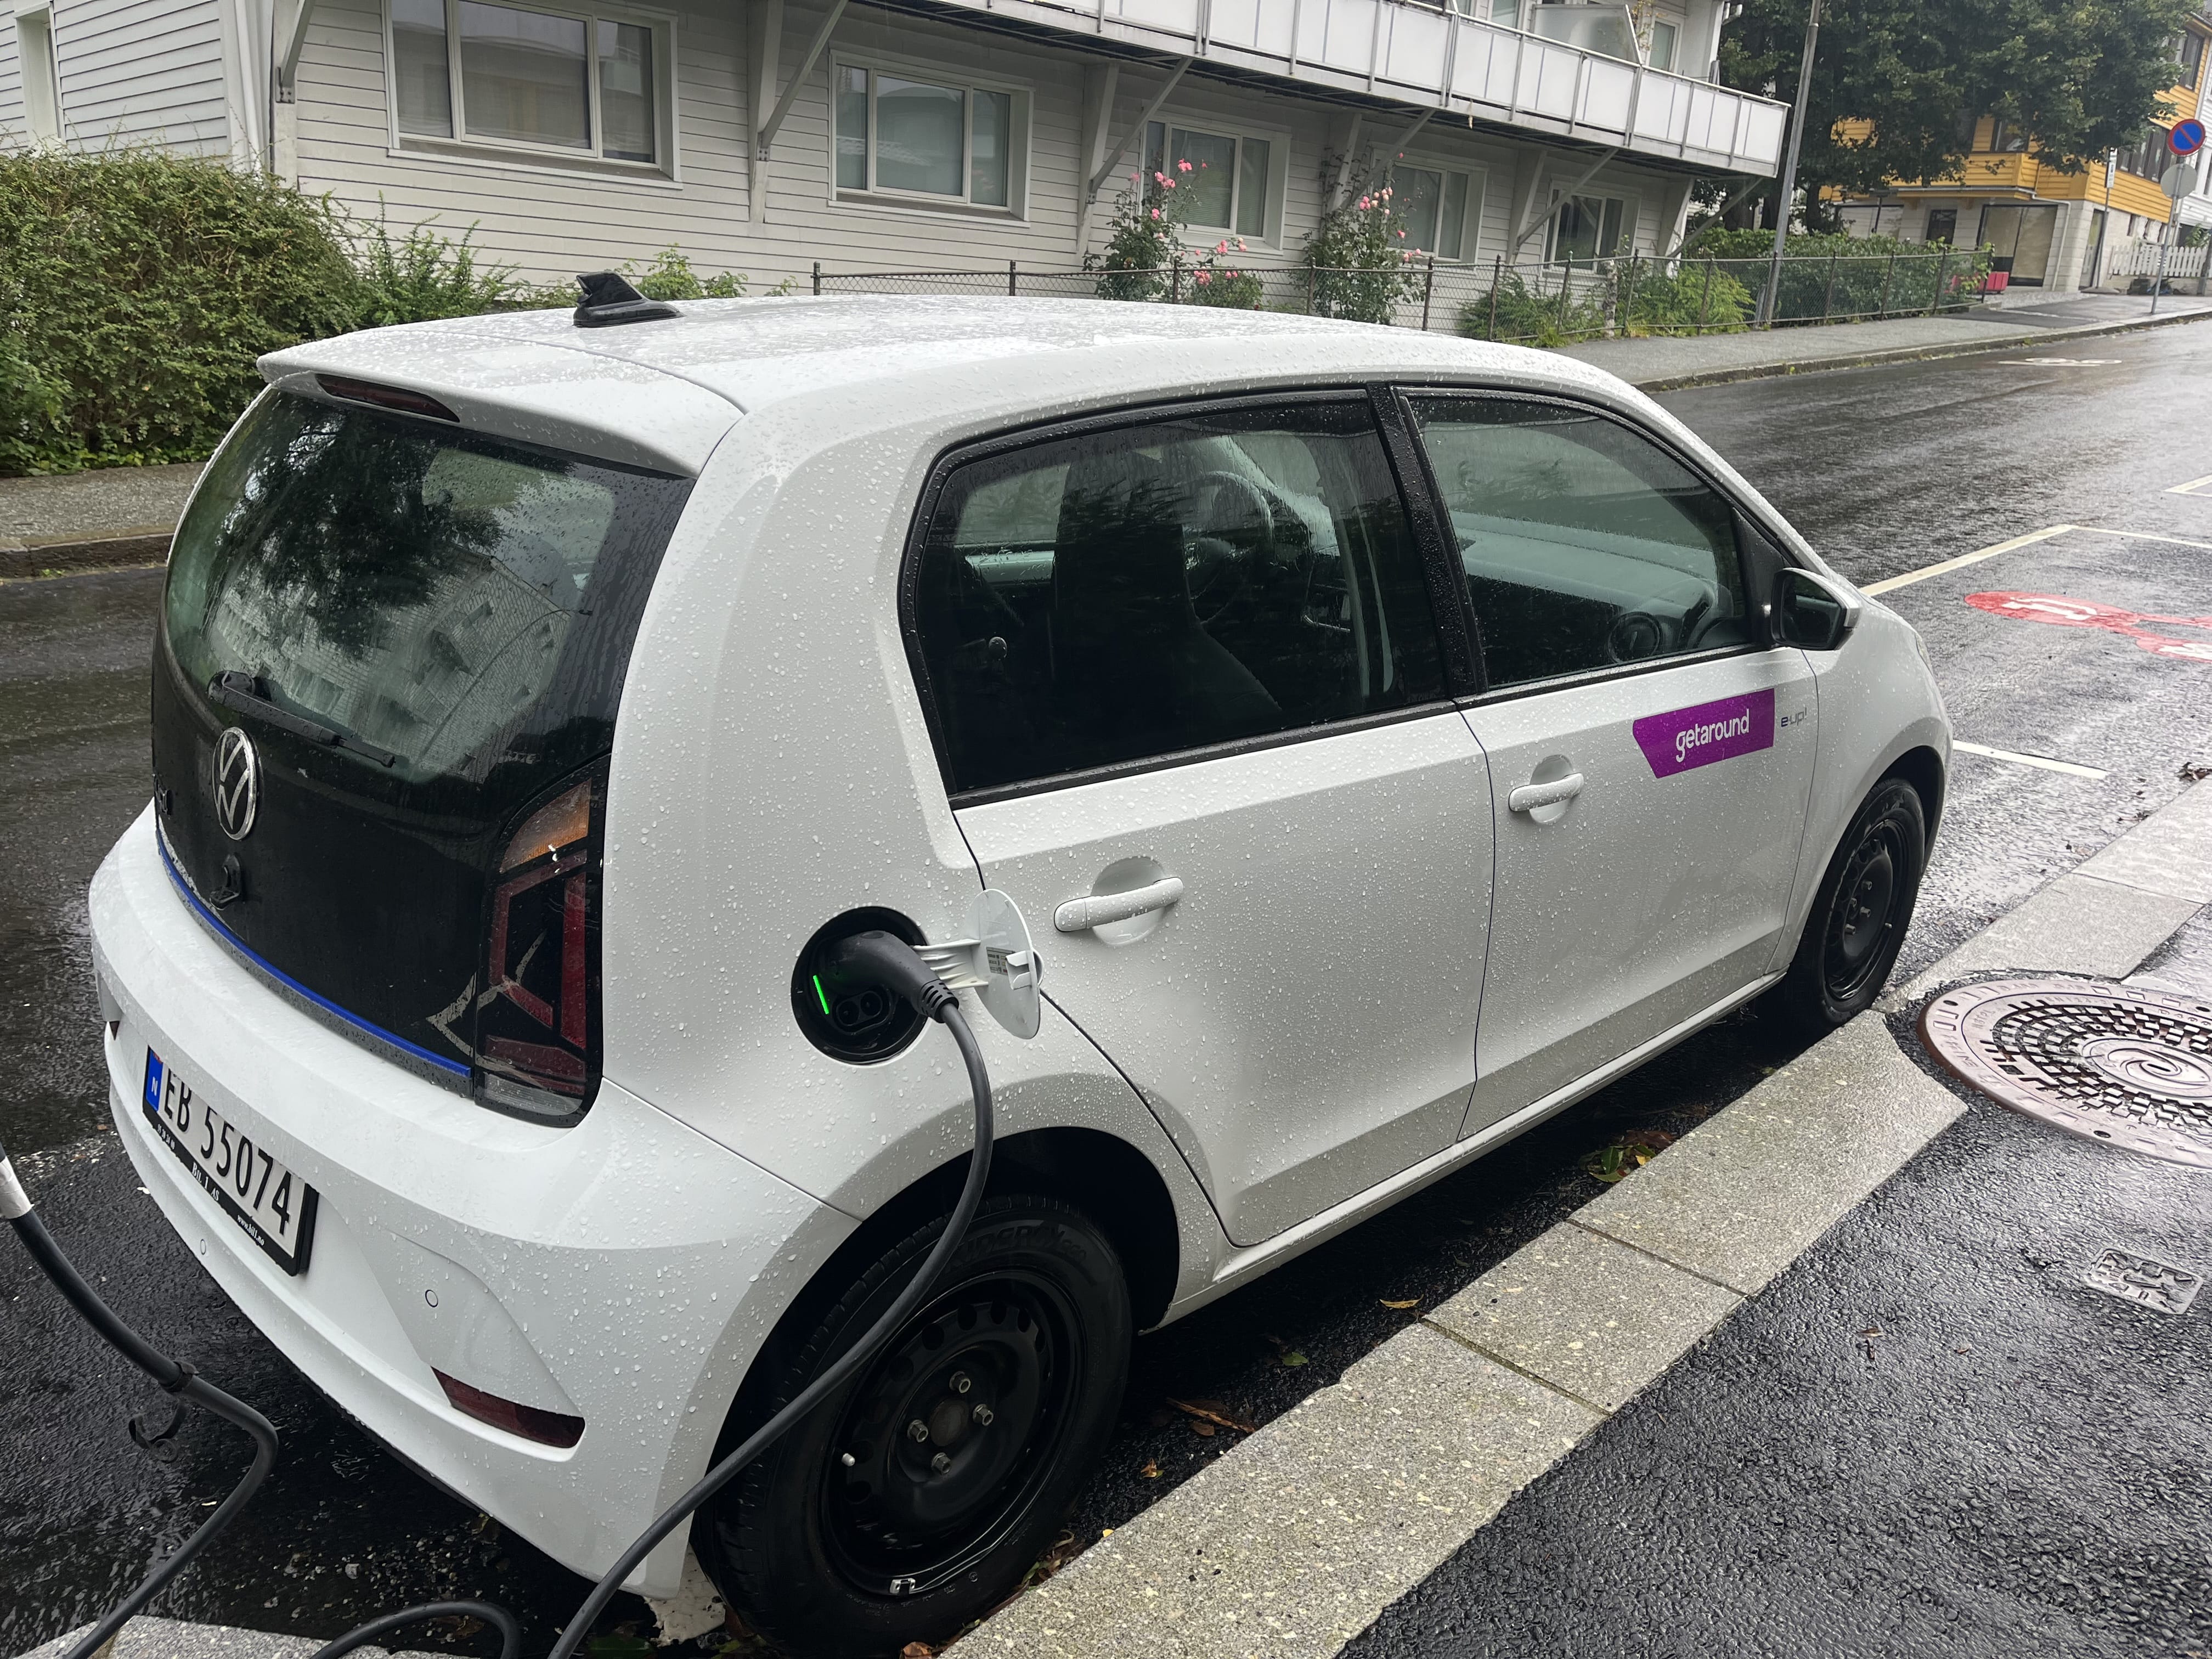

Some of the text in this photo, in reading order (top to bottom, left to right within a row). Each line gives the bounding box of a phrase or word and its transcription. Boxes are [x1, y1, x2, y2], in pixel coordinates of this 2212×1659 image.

[1675, 708, 1750, 763] getaround
[151, 1076, 158, 1097] N
[165, 1068, 293, 1236] EB 55074
[211, 1187, 219, 1201] AS
[237, 1215, 264, 1246] www.bil1.no
